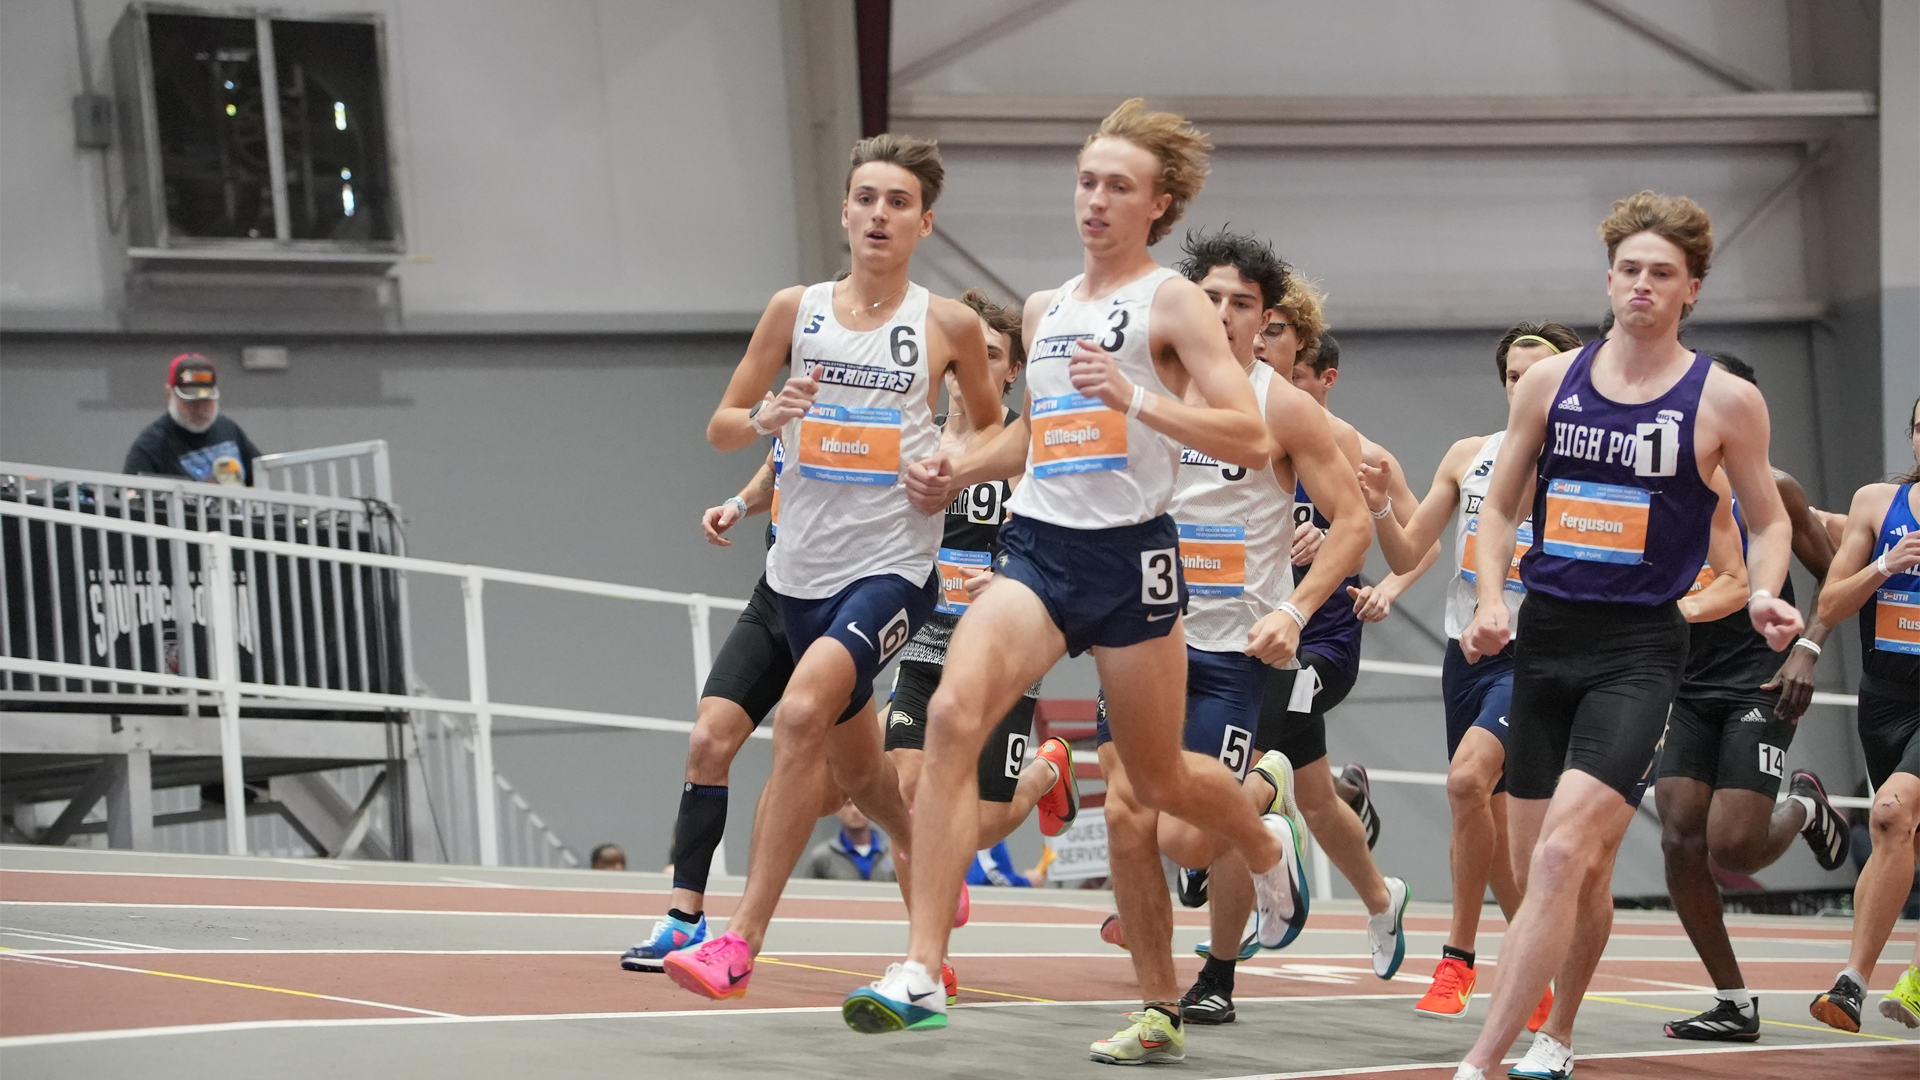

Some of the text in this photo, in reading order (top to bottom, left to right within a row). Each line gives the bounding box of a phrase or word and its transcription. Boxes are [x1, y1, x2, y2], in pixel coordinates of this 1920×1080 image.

[889, 325, 919, 367] 6
[1100, 309, 1129, 352] 3
[803, 359, 915, 394] BCCANEERS
[1558, 403, 1583, 412] adidas
[821, 437, 870, 455] Iriondo
[1553, 421, 1637, 469] HIGH PO
[1643, 428, 1662, 473] 1
[972, 483, 997, 521] 9
[1559, 512, 1623, 533] Ferguson
[1148, 553, 1172, 600] 3
[882, 619, 908, 655] 6
[1009, 738, 1026, 776] 9
[1223, 729, 1248, 773] 5
[1762, 746, 1783, 776] 14
